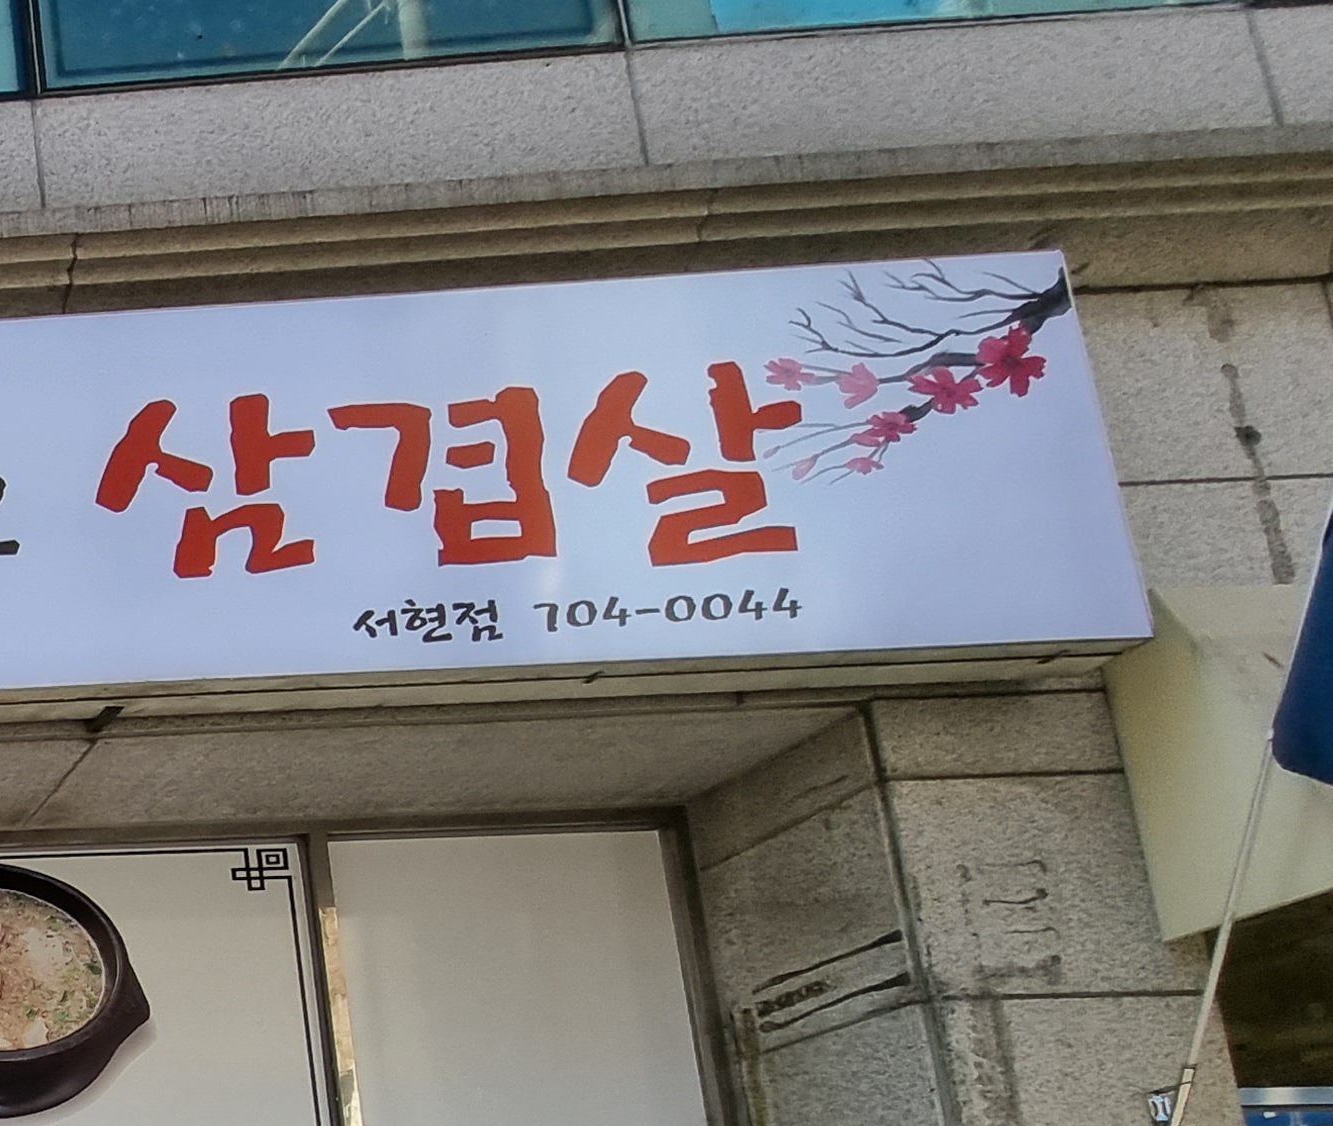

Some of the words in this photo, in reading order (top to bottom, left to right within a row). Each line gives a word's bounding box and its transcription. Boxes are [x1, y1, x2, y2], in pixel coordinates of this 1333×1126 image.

[95, 360, 805, 580] 삼겹살
[353, 599, 503, 642] 서현점
[533, 588, 802, 632] 704-0044
